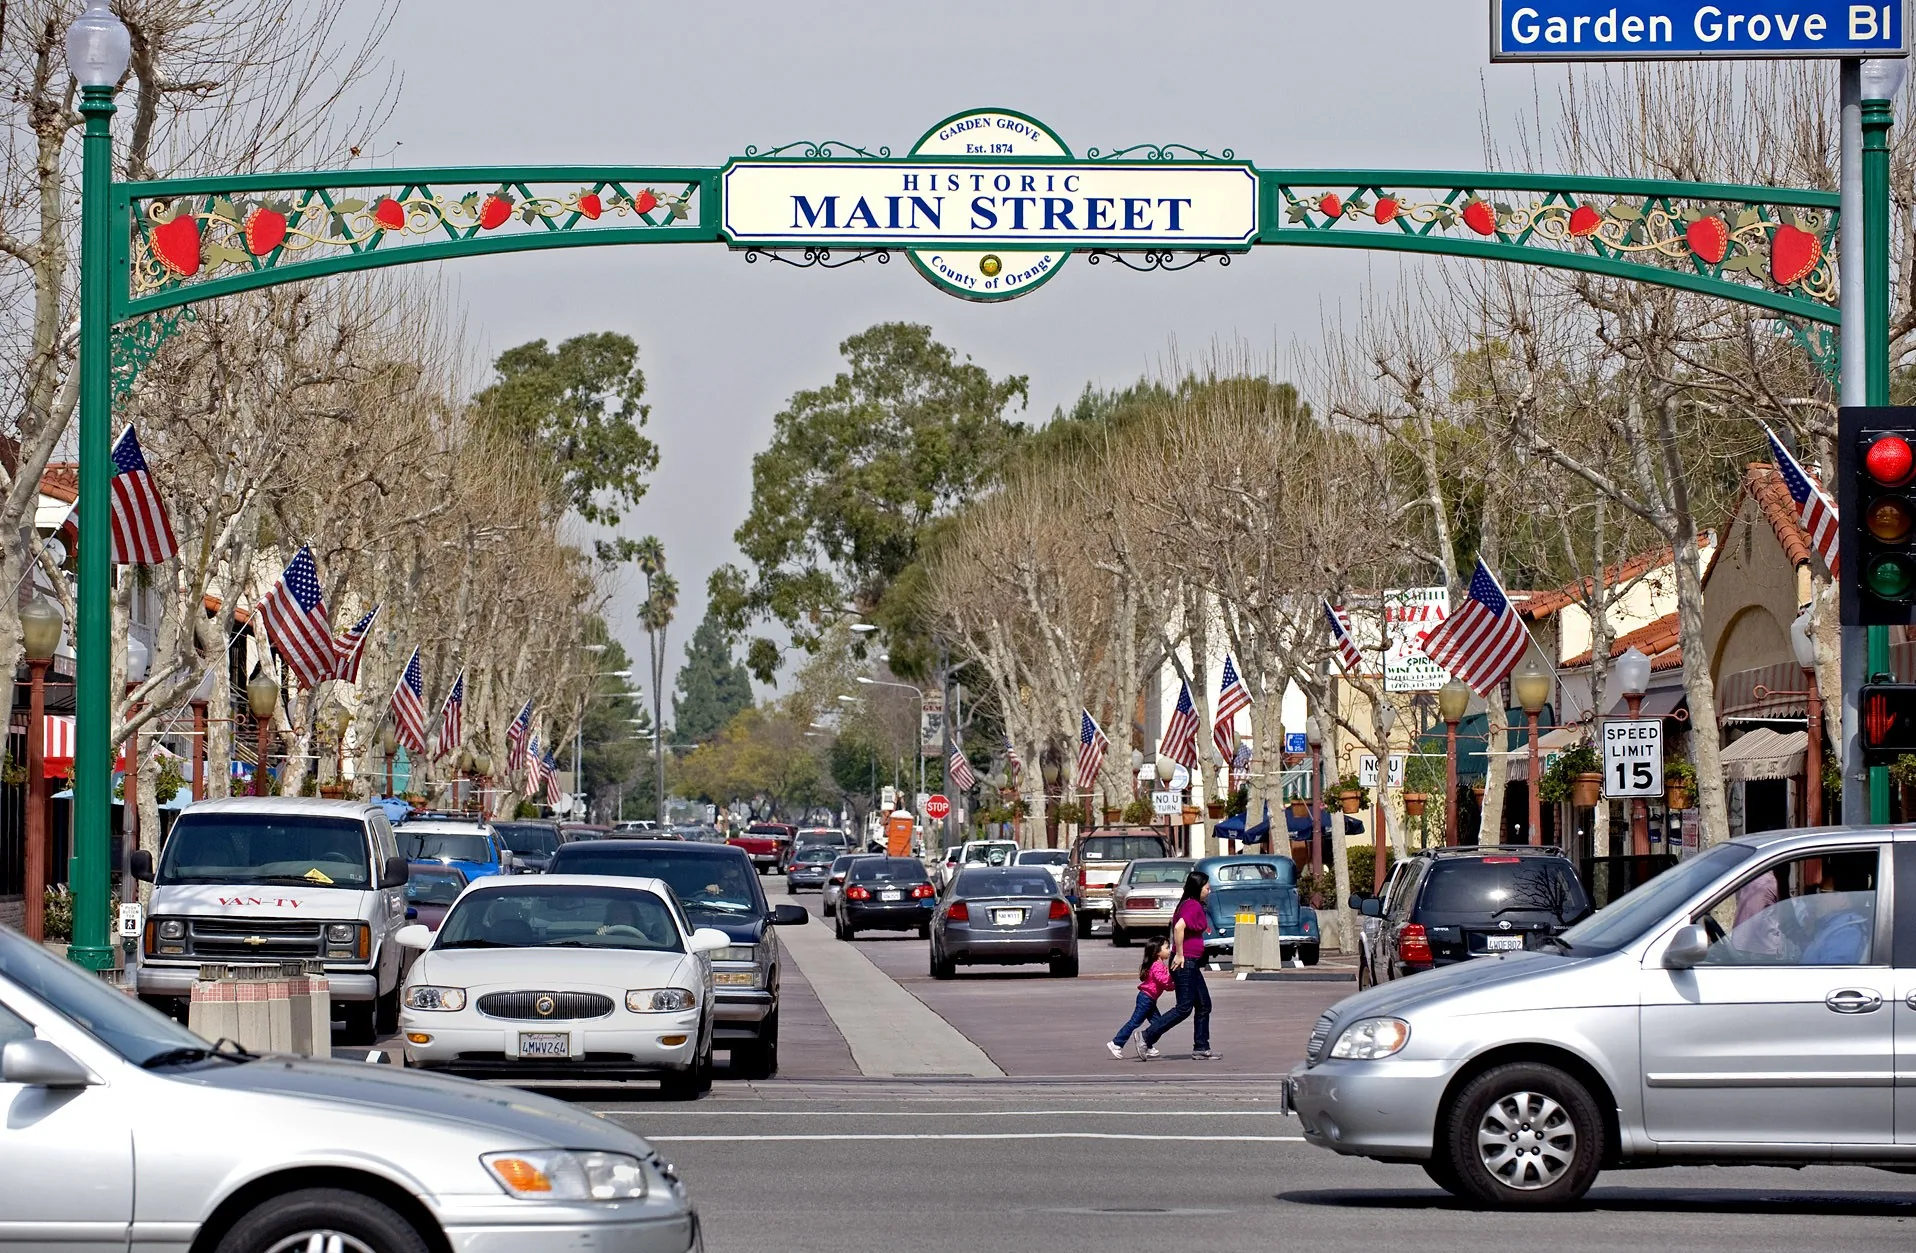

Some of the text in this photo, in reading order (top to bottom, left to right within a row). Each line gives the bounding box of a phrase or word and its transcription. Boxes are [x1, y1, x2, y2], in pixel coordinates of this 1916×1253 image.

[1511, 7, 1673, 44] Garden
[1693, 5, 1828, 42] Grove
[940, 118, 1040, 142] GARDEN GROVE
[966, 144, 1013, 153] Est. 1874
[903, 174, 1080, 192] HISTORIC
[789, 196, 1192, 231] MAIN STREET
[931, 254, 1052, 289] County of Orange
[1607, 728, 1658, 740] SPEED
[1612, 745, 1653, 757] LIMIT
[1389, 760, 1398, 771] U
[1616, 762, 1653, 790] 15
[1156, 795, 1178, 804] NO U
[927, 802, 949, 812] STOP
[522, 1042, 566, 1053] 4MWV264
